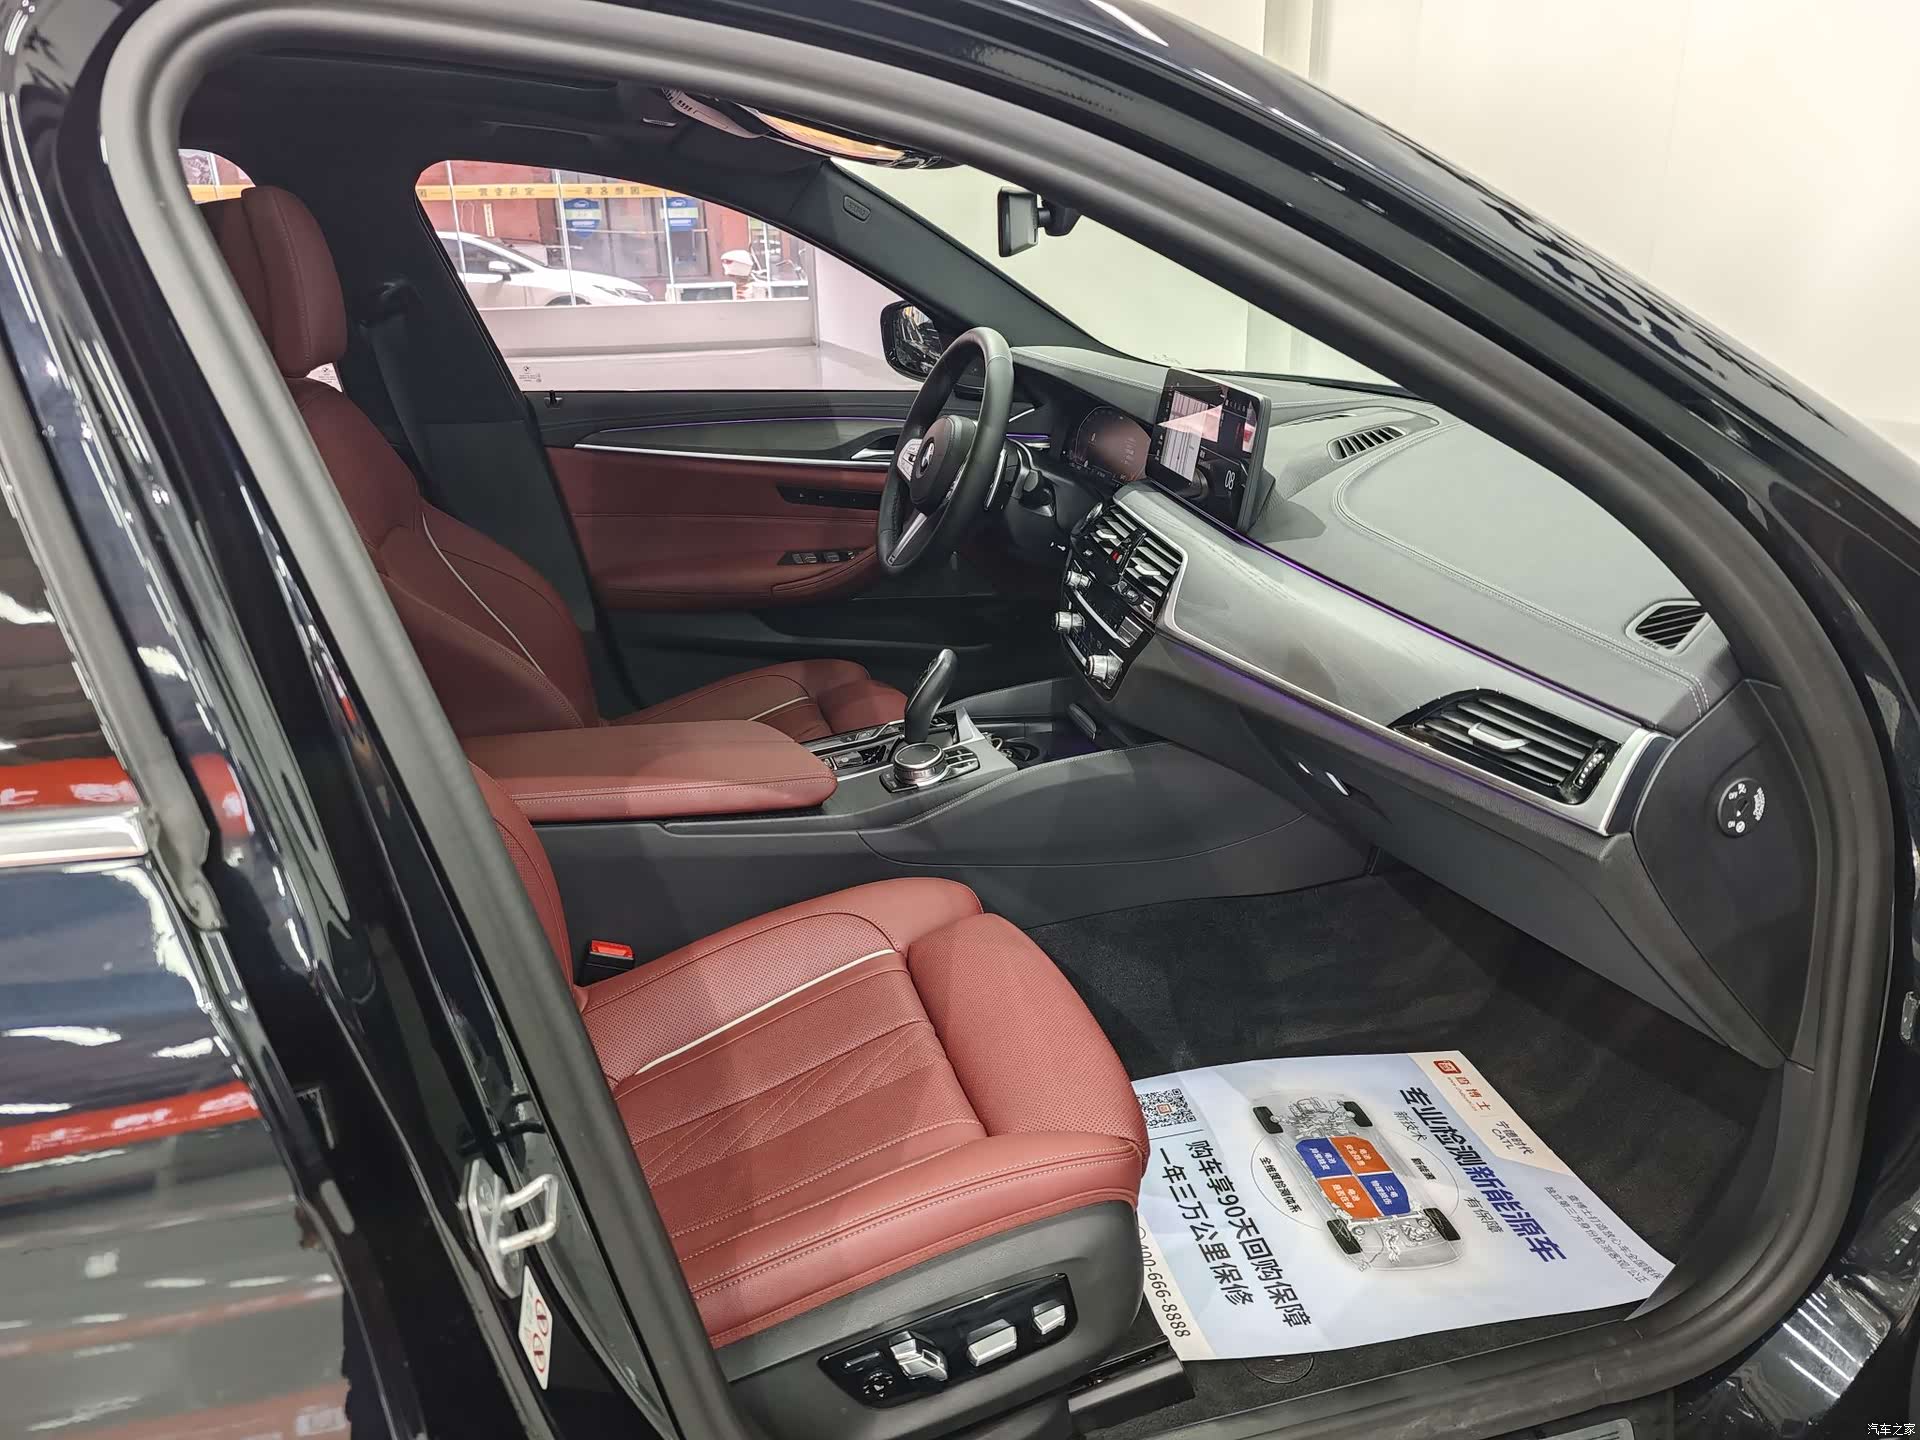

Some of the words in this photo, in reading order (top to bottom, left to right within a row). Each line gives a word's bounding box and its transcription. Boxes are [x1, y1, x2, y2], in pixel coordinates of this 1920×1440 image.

[1259, 1157, 1302, 1213] 全维度检测体系
[1394, 1111, 1428, 1141] 新技术
[1463, 1197, 1504, 1234] 有保障
[1400, 1087, 1567, 1263] 专业检测新能源车
[1491, 1128, 1514, 1151] CATL
[1496, 1120, 1534, 1155] 宁德时代
[1160, 1147, 1255, 1306] 一年三万公里保修
[1185, 1139, 1312, 1328] 购车享90天回购保障
